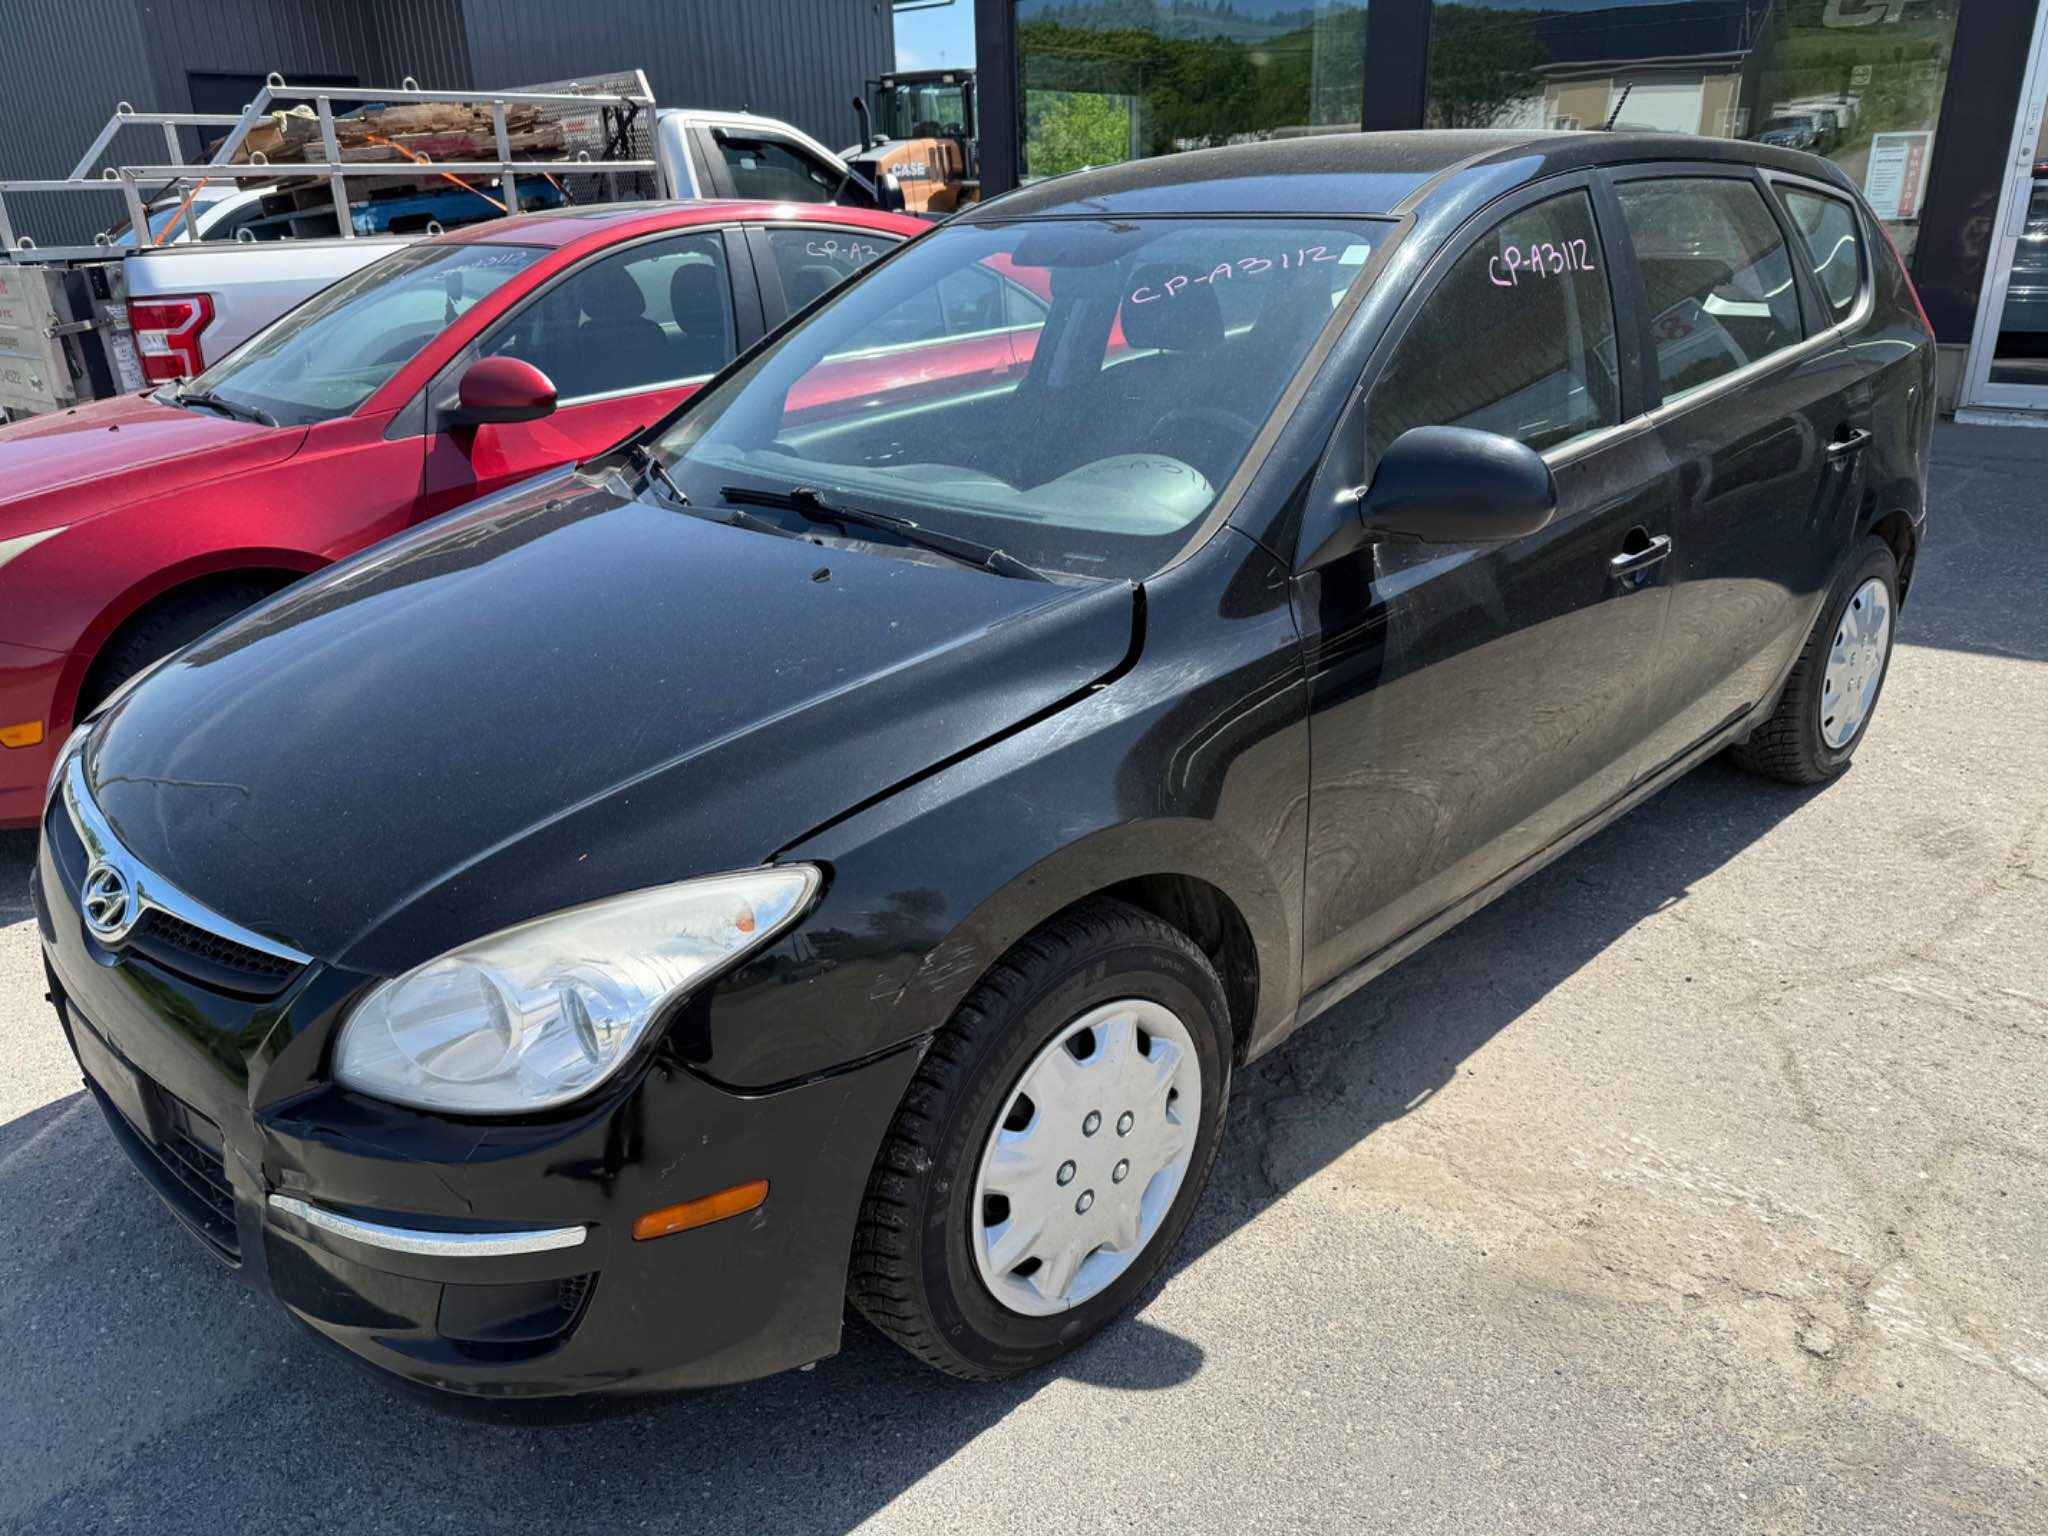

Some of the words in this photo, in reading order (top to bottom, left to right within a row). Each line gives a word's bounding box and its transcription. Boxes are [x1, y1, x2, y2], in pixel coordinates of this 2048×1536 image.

[891, 160, 926, 177] CASE
[1131, 246, 1337, 303] CP-A3112
[1489, 239, 1595, 286] CP-A3112
